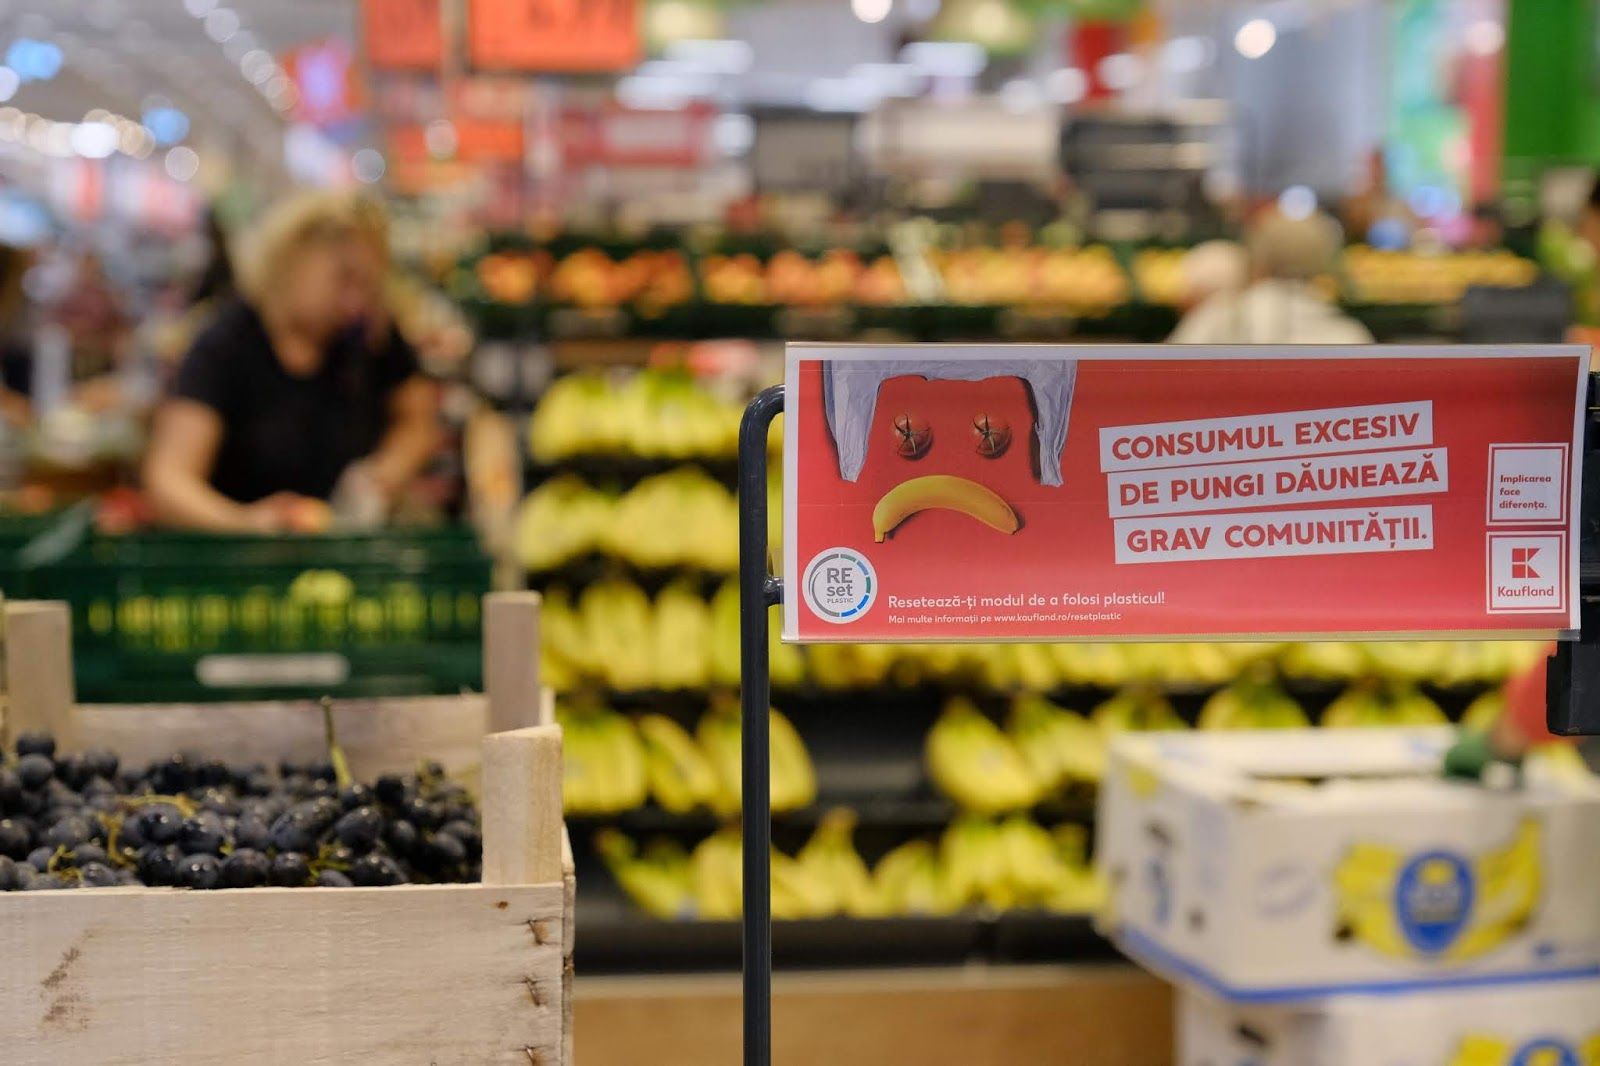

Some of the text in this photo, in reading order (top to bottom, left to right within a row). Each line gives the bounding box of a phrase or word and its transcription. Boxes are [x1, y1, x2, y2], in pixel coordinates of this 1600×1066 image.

[1112, 412, 1420, 460] CONSUMUL EXCESIV
[1120, 452, 1439, 506] DE PUNGI DĂUNEAZĂ
[1500, 474, 1552, 485] Implicarea
[1499, 488, 1521, 496] face
[1499, 500, 1547, 511] diferența.
[1127, 511, 1427, 553] GRAV COMUNITĂȚII.
[826, 567, 853, 583] RE
[826, 584, 853, 597] set
[1497, 585, 1555, 597] Kaufland
[888, 591, 1166, 610] Resetează-ți modul de a folosi plasticul!
[888, 612, 1122, 625] Mai multe informații pe www.kaufland.ro/resetplastic
